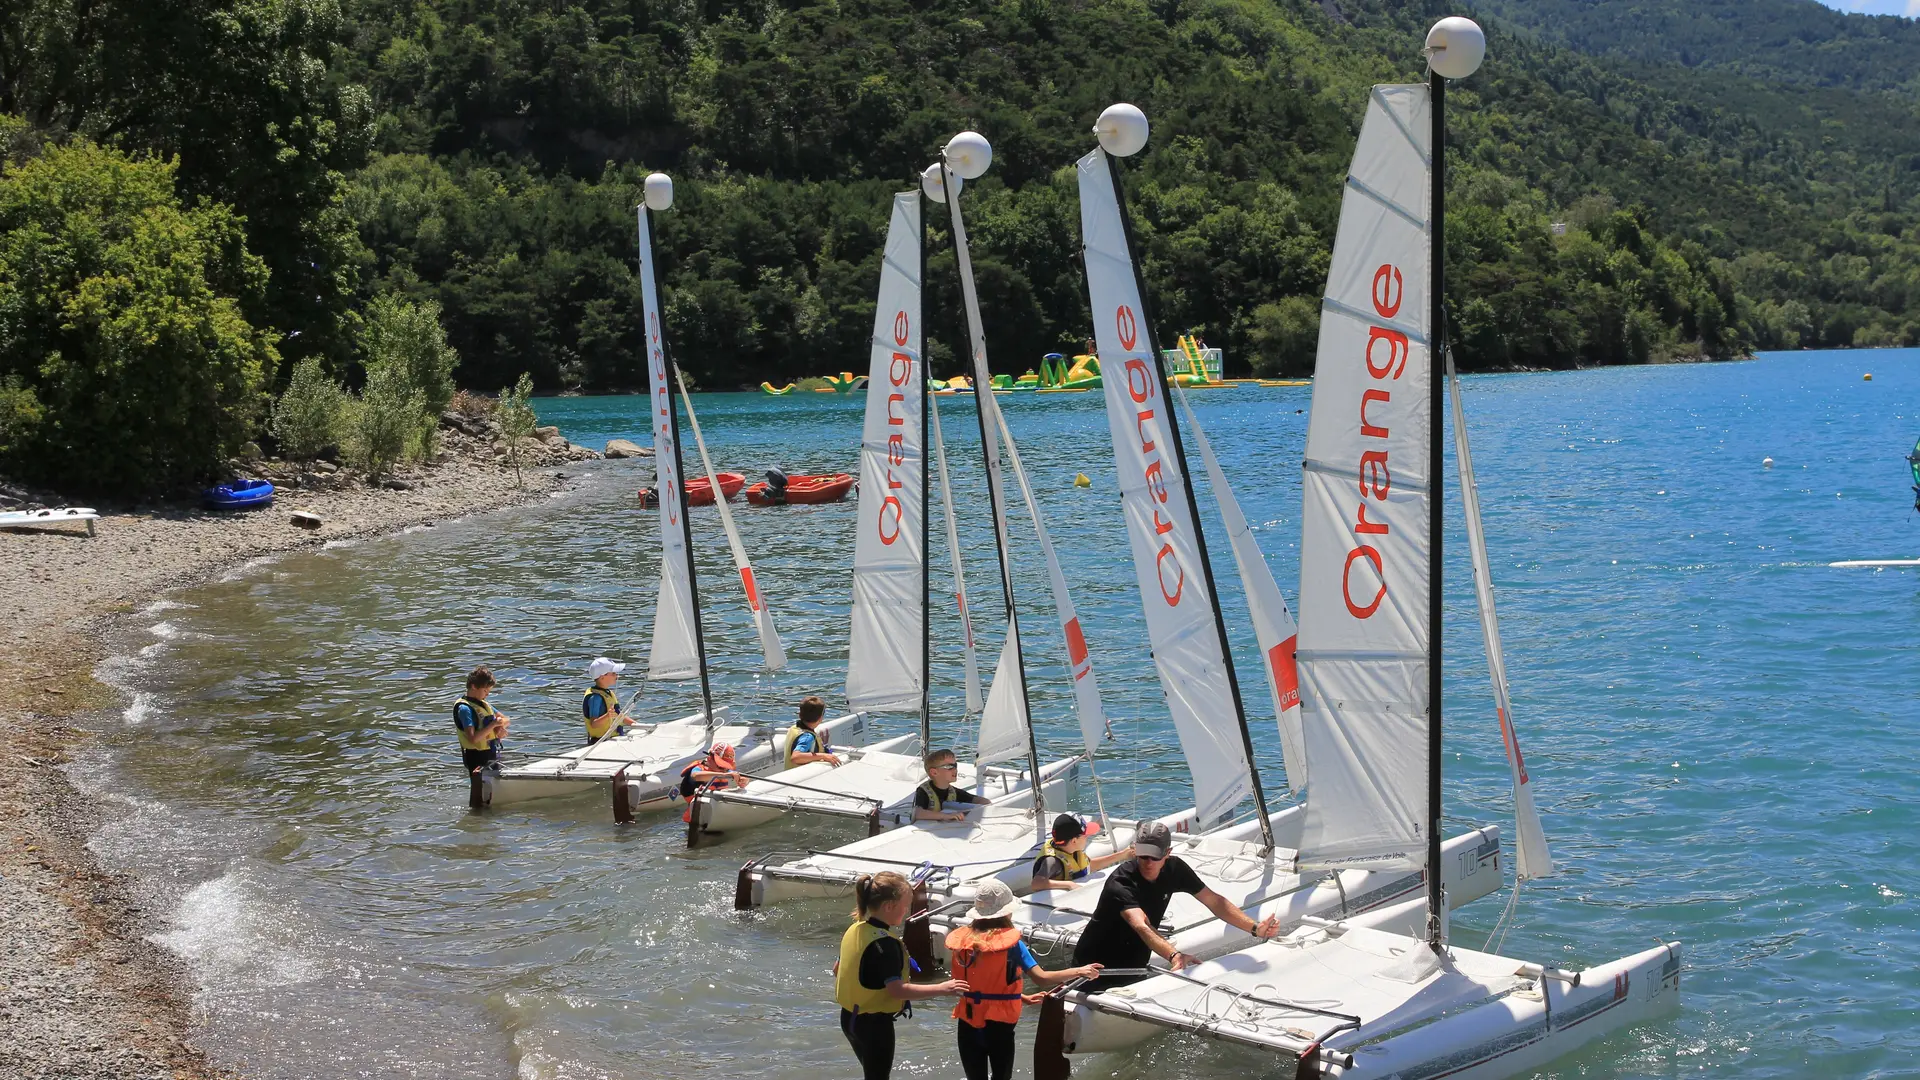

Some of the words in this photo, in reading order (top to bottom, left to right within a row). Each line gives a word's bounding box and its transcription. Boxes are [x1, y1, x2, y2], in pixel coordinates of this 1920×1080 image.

[651, 312, 677, 526] Onge
[878, 310, 912, 545] Orange
[1117, 305, 1184, 607] Orange
[1342, 264, 1408, 619] Orange
[1458, 847, 1478, 880] 10
